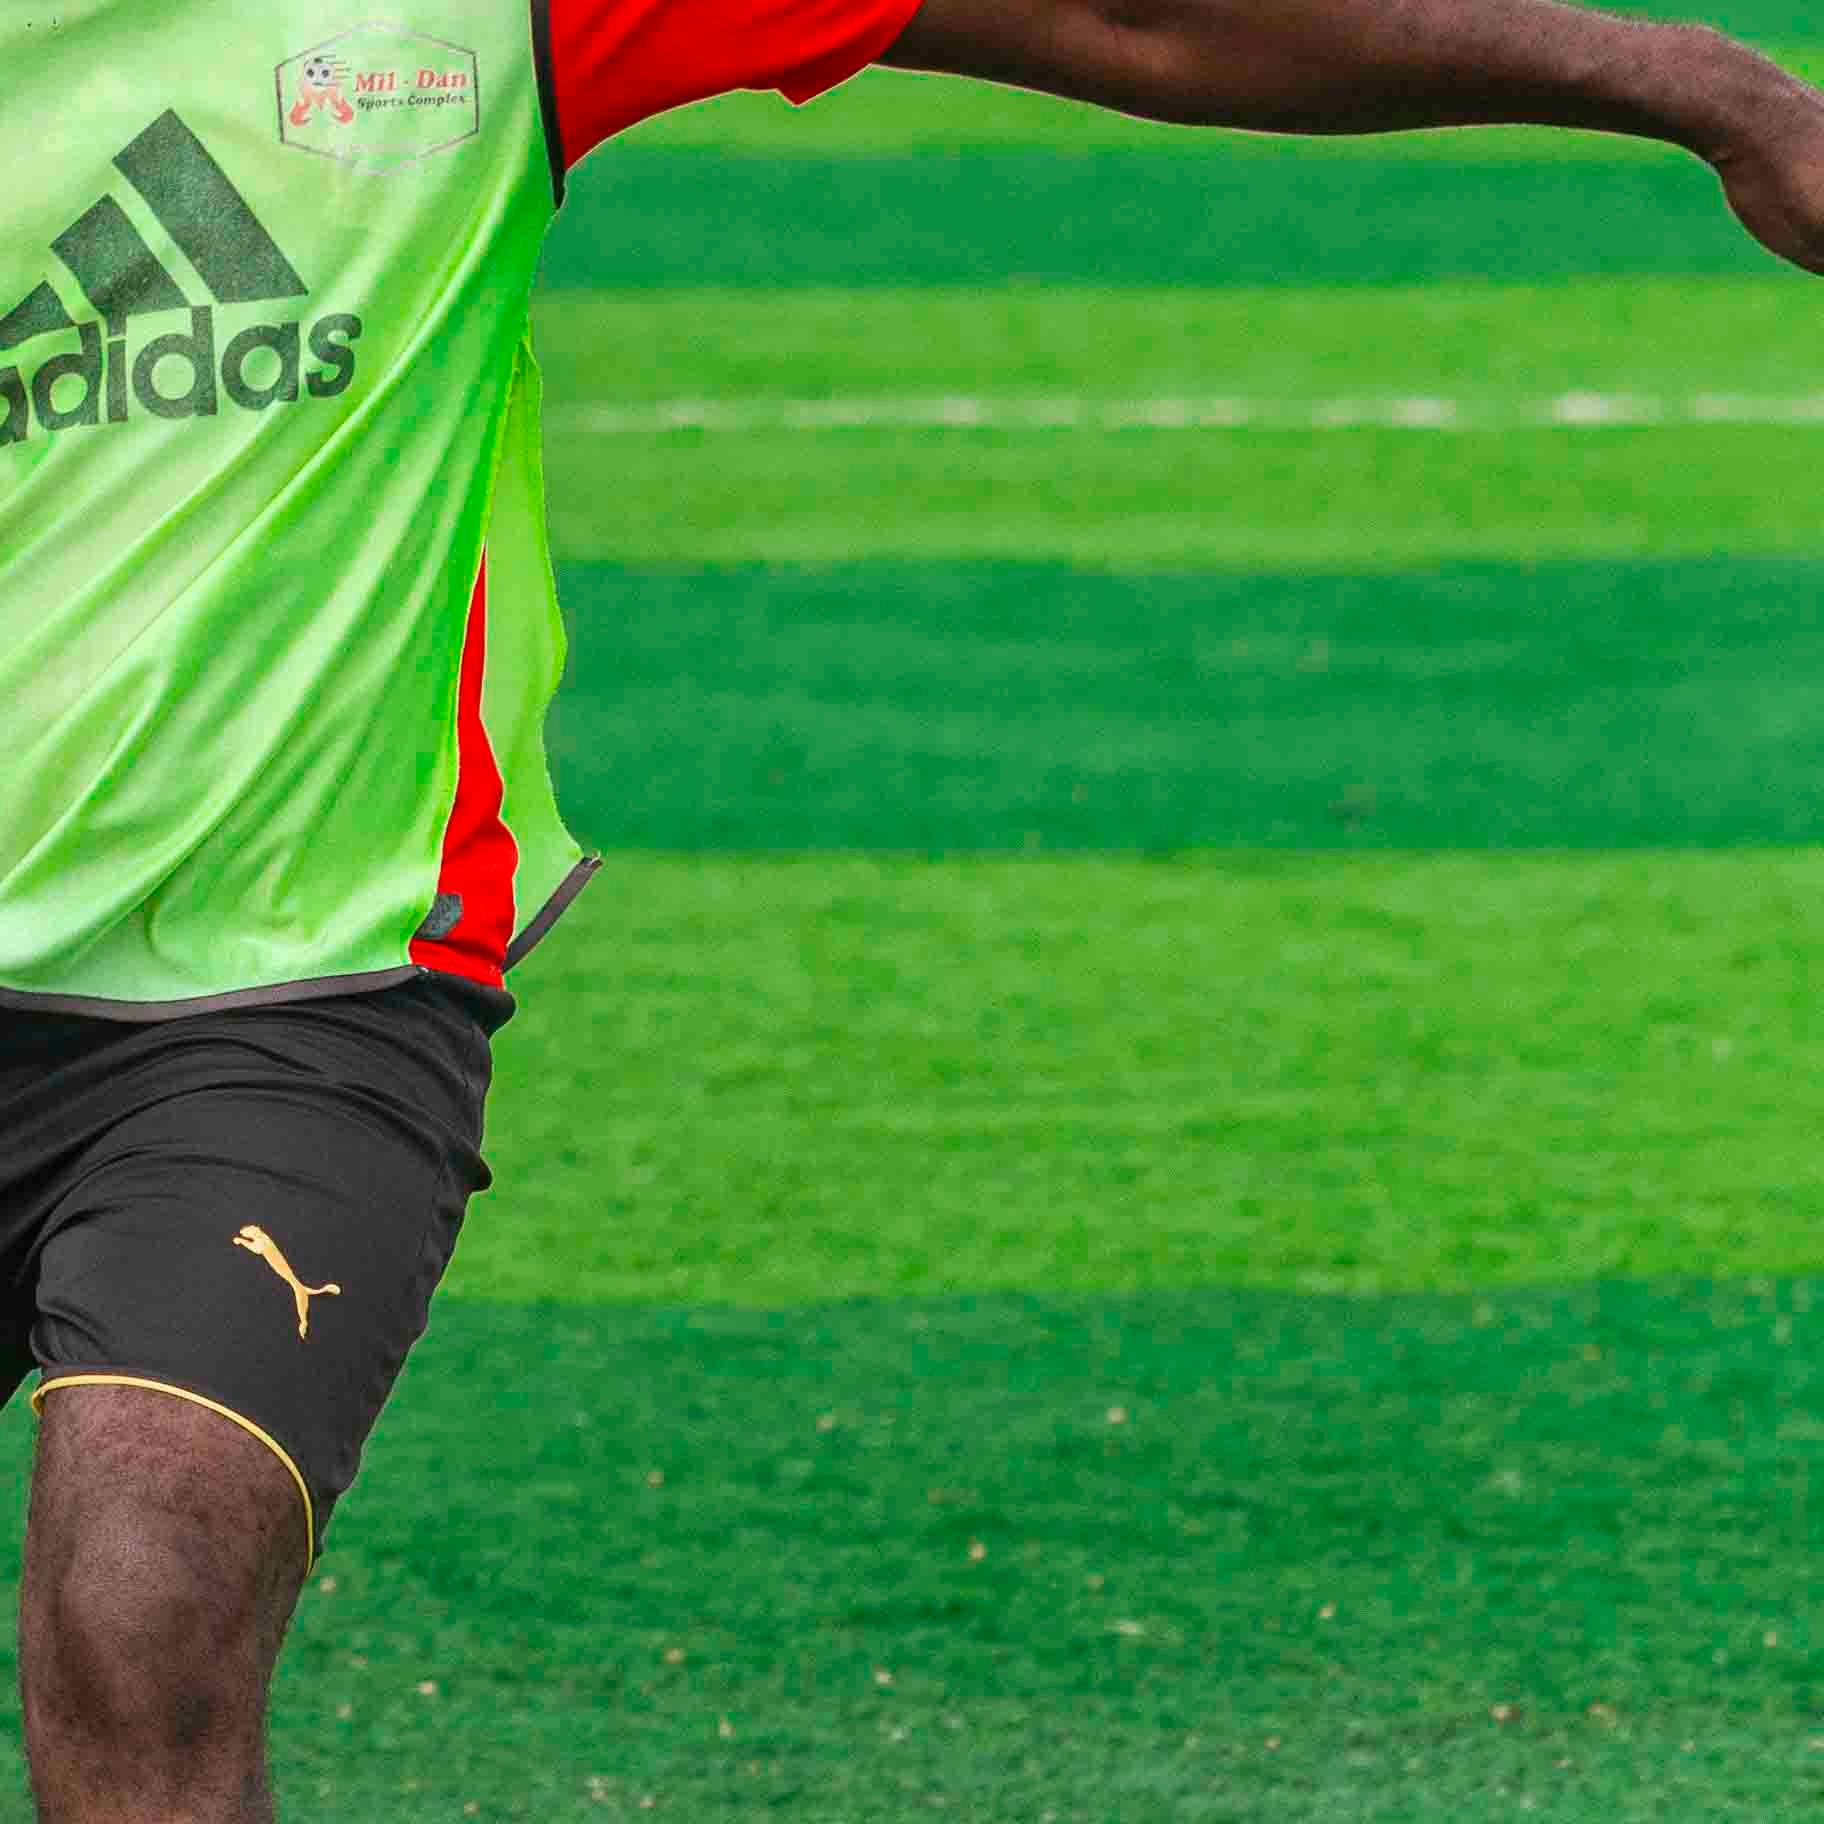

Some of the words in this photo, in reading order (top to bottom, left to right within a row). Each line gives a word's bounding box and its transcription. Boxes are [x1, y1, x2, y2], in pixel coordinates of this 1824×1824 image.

[354, 70, 396, 92] Mil
[416, 69, 465, 89] Dan
[407, 92, 465, 107] Complex
